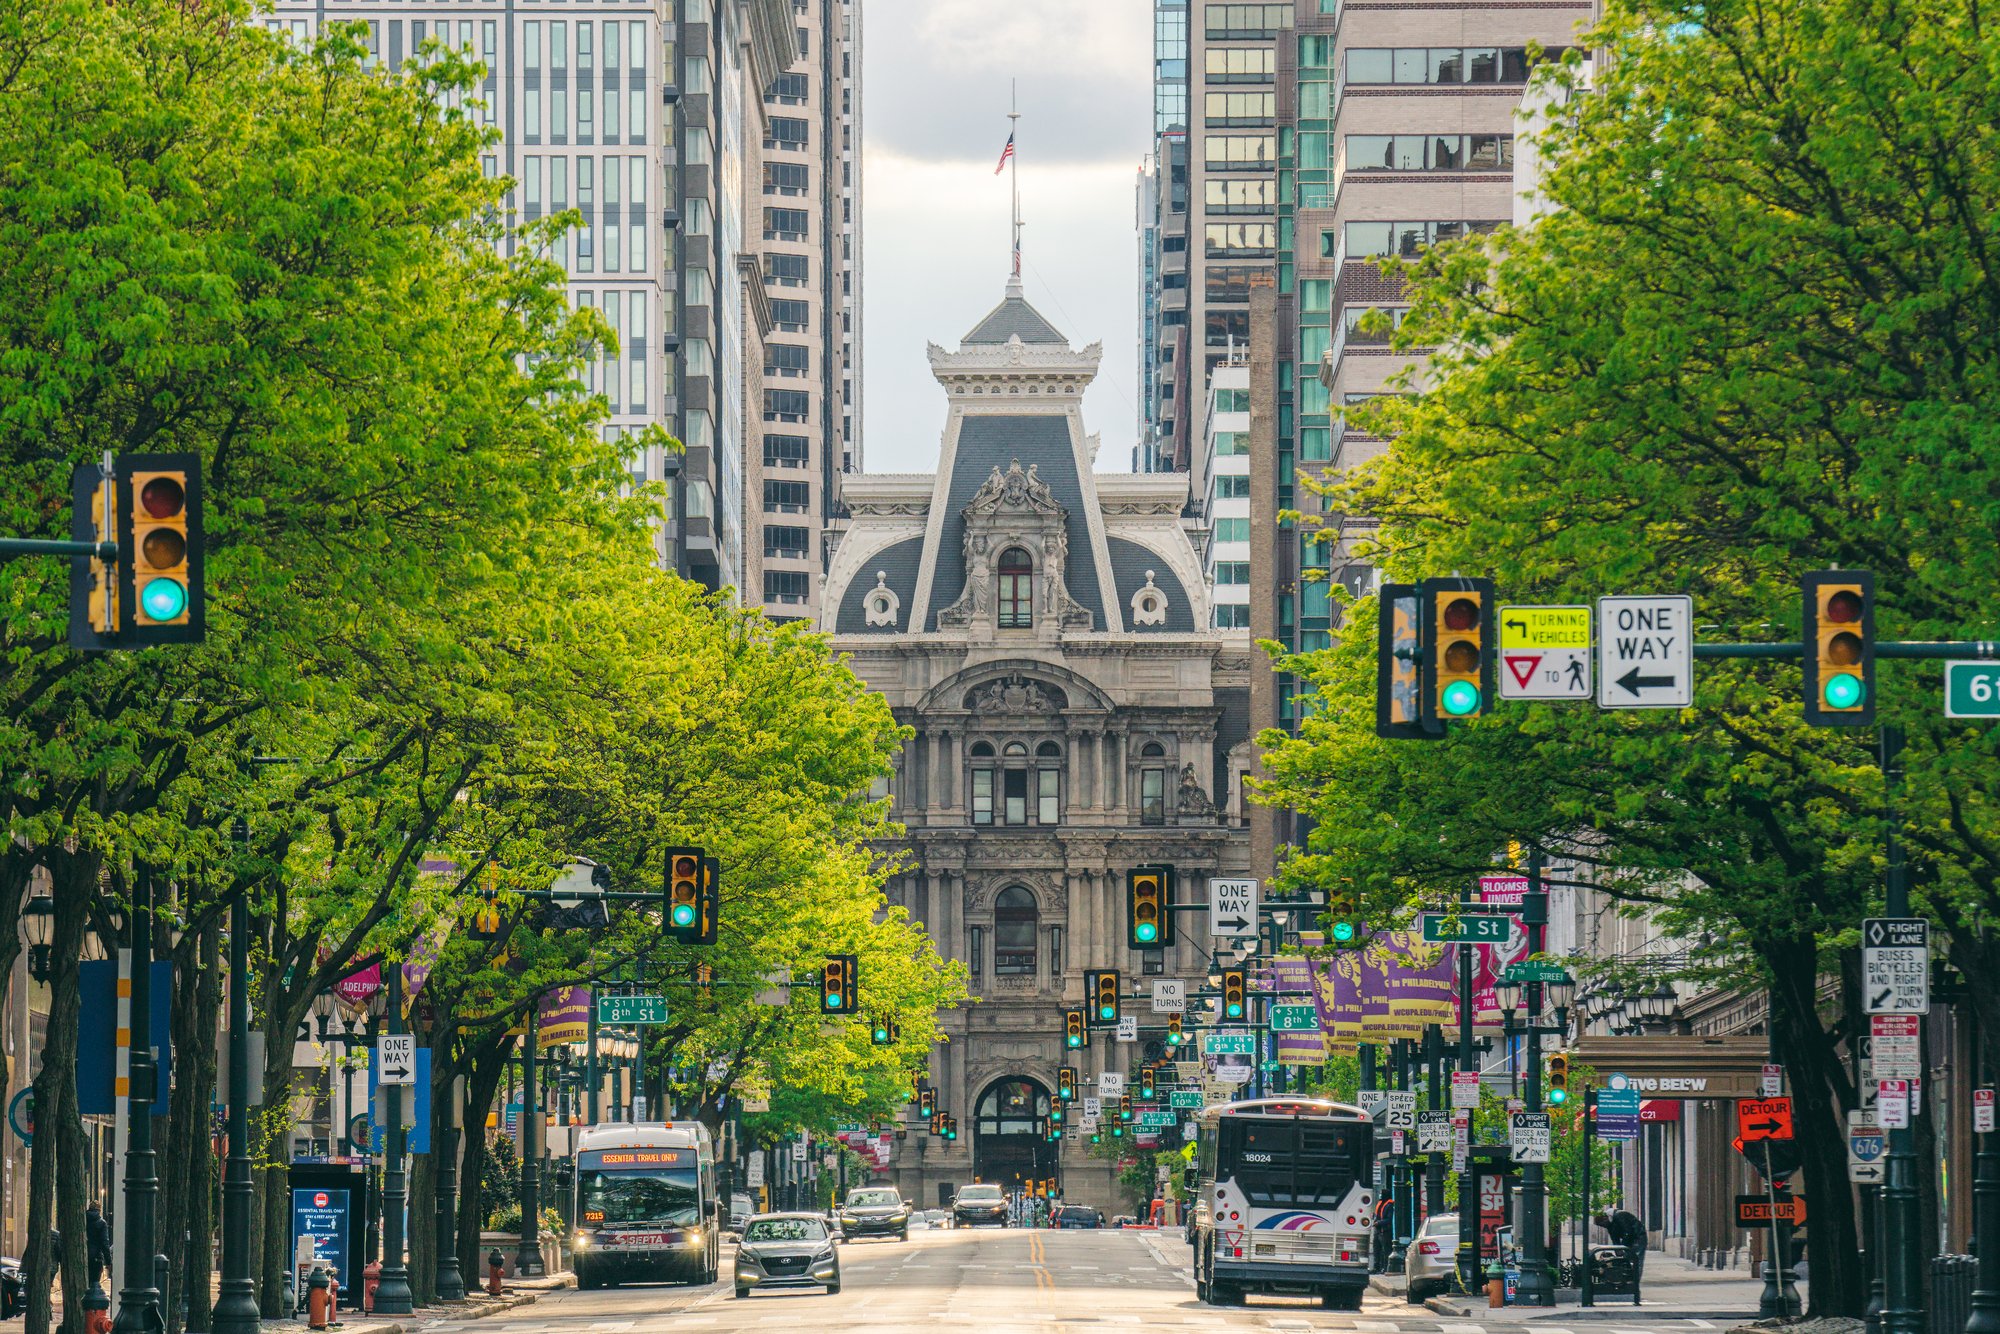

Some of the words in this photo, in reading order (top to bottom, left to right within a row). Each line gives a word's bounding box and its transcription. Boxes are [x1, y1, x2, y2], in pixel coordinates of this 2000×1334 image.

[1531, 614, 1586, 627] TURNING
[1618, 608, 1671, 631] ONE
[1531, 631, 1586, 643] VEHICLES
[1617, 637, 1675, 660] WAY
[1545, 671, 1559, 683] TO
[1219, 884, 1249, 897] ONE
[1219, 900, 1250, 912] WAY
[1435, 919, 1467, 936] 7h
[1477, 920, 1499, 936] St
[1888, 923, 1925, 933] RIGHT
[1891, 934, 1924, 945] LANE
[1877, 950, 1914, 961] BUSES
[1277, 967, 1294, 975] WEST
[1868, 962, 1924, 974] BICYCLES
[1539, 972, 1564, 981] STREET
[1870, 974, 1890, 985] AND
[1894, 974, 1923, 985] RIGHT
[1391, 980, 1400, 988] in
[1401, 977, 1452, 991] PHILADELPHIA
[1162, 985, 1176, 995] NO
[1895, 986, 1924, 997] TURN
[1155, 999, 1183, 1007] TURNS
[1336, 1004, 1343, 1012] in
[1482, 998, 1496, 1007] 701
[1895, 997, 1924, 1008] ONLY
[547, 1005, 588, 1018] PHILADELPHIA
[612, 1008, 631, 1021] 8th
[639, 1008, 655, 1021] St
[1393, 1008, 1453, 1018] WCUPA.EDU/PHILLY
[1283, 1016, 1302, 1028] 8th
[550, 1029, 574, 1041] MARKET
[384, 1039, 409, 1051] ONE
[1214, 1043, 1229, 1052] 9th
[1234, 1043, 1246, 1053] St
[384, 1052, 410, 1064] WAY
[1104, 1076, 1118, 1085] NO
[1887, 1081, 1900, 1091] NO
[1099, 1087, 1122, 1095] TURNS
[1175, 1099, 1192, 1107] 10th
[1361, 1093, 1379, 1102] ONE
[1389, 1095, 1415, 1103] SPEED
[1742, 1102, 1788, 1116] DETOUR
[1390, 1111, 1413, 1126] 25
[1526, 1114, 1548, 1122] RIGHT
[1640, 1110, 1657, 1120] C21
[1861, 1113, 1874, 1123] TO
[1536, 1130, 1549, 1138] AND
[1515, 1137, 1549, 1146] BICYCLES
[1530, 1149, 1548, 1157] ONLY
[1855, 1139, 1880, 1156] 676
[602, 1154, 635, 1164] ESSENTIAL
[636, 1154, 661, 1163] TRAVEL
[661, 1153, 678, 1162] ONLY
[1245, 1153, 1272, 1162] 18024
[585, 1212, 604, 1221] 7315
[1743, 1204, 1796, 1218] DETOUR
[628, 1234, 663, 1246] SEPTA
